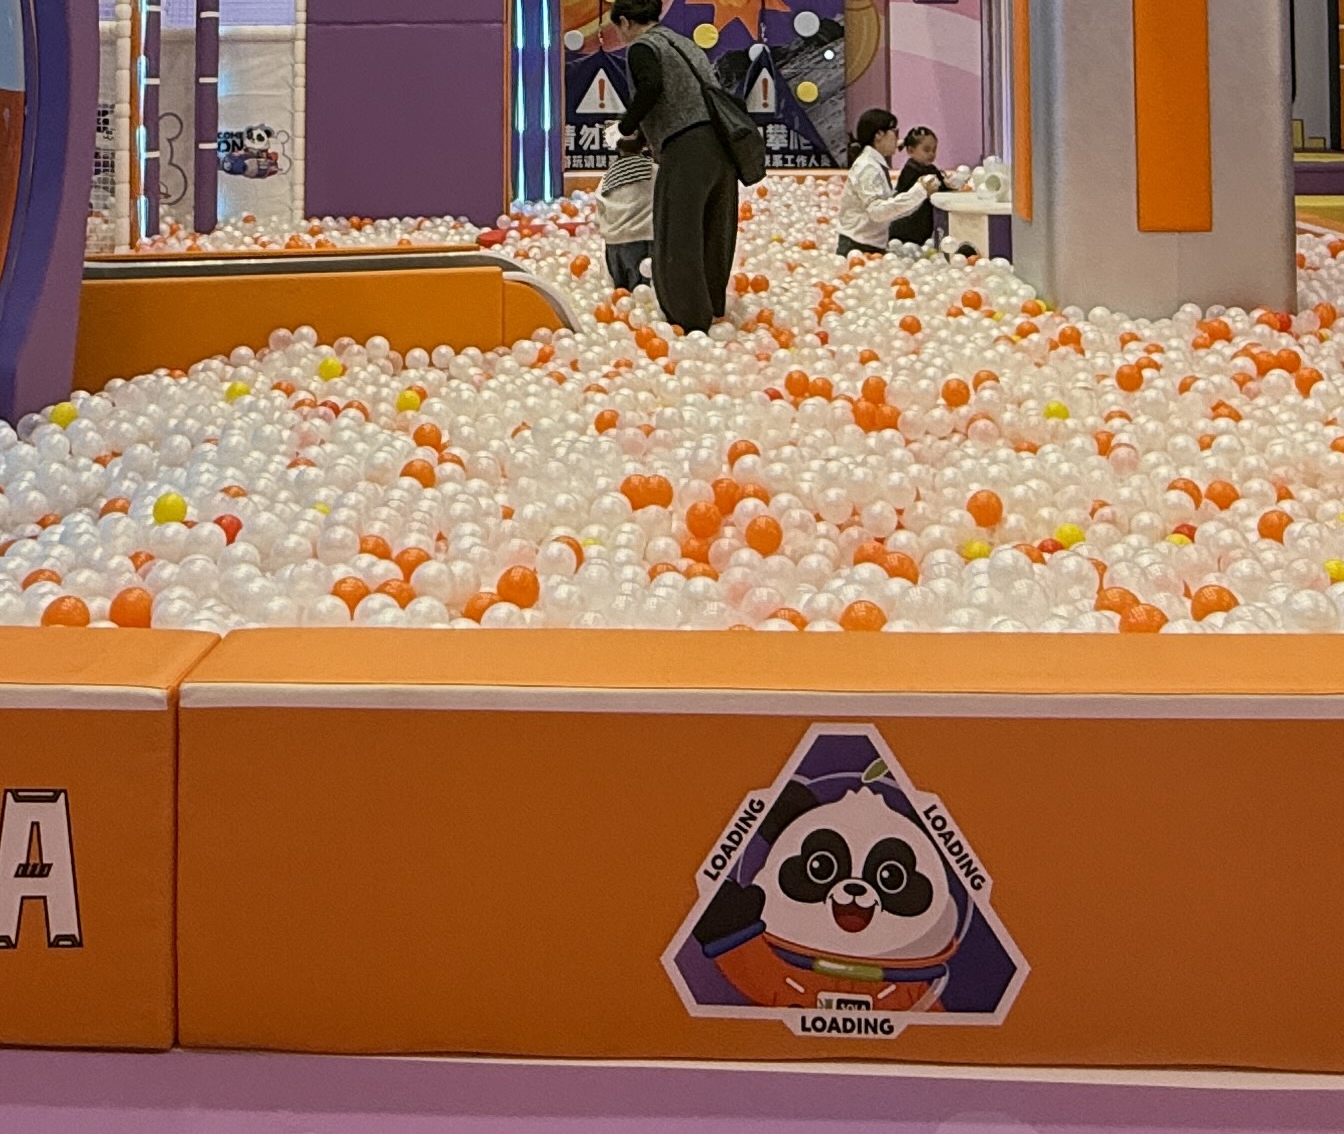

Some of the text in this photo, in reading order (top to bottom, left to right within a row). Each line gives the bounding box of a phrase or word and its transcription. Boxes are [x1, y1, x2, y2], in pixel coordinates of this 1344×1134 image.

[703, 797, 766, 882] LOADING
[922, 804, 987, 892] LOADING
[800, 1015, 895, 1035] LOADING
